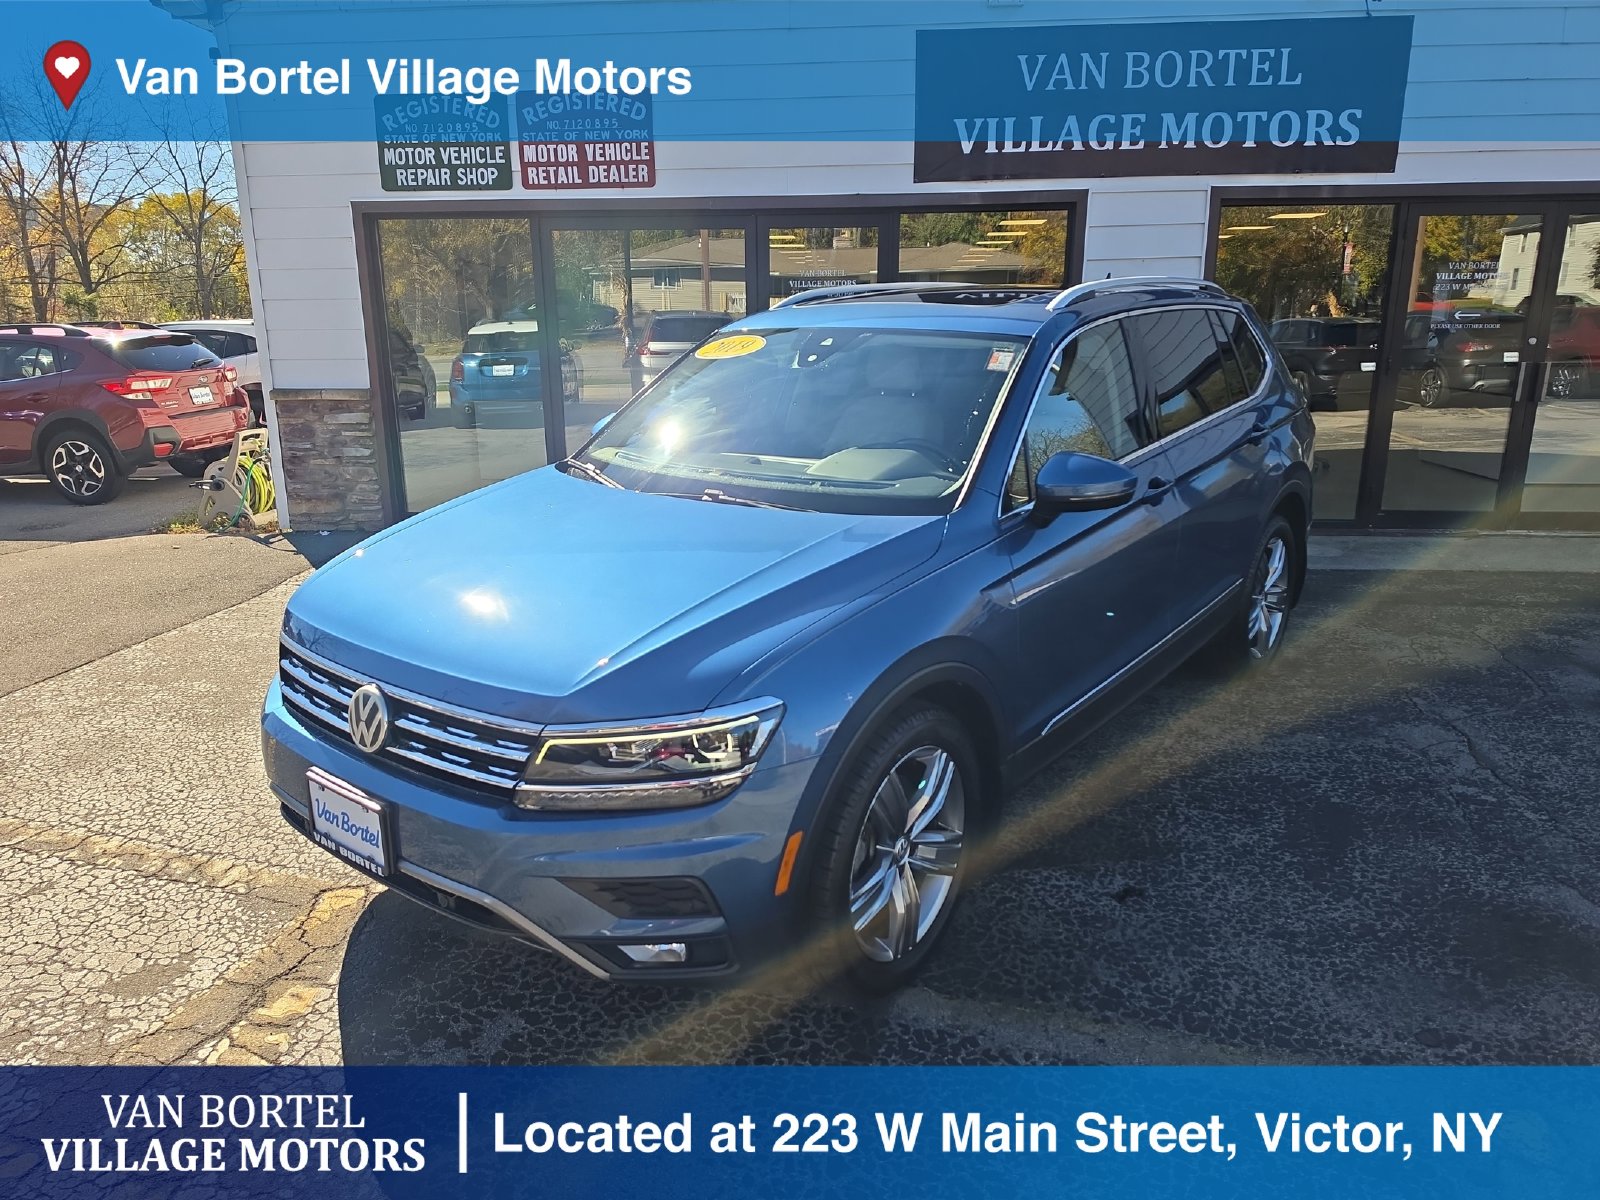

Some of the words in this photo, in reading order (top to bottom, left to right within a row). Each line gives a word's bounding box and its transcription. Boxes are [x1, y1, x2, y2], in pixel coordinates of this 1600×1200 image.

[1017, 51, 1109, 91] VAN
[1123, 48, 1303, 89] BORTEL
[382, 95, 500, 132] REGISTERED
[521, 91, 647, 126] REGISTERED
[564, 118, 619, 129] 7120895
[954, 113, 1147, 154] VILLAGE
[1158, 109, 1363, 148] MOTORS
[384, 134, 419, 144] STATE
[423, 133, 437, 144] OF
[441, 132, 467, 143] NEW
[470, 132, 502, 143] YORK
[522, 131, 558, 142] STATE
[564, 131, 579, 141] OF
[585, 130, 610, 140] NEW
[615, 129, 649, 140] YORK
[383, 147, 436, 166] MOTOR
[440, 145, 506, 165] VEHICLE
[523, 143, 578, 163] MOTOR
[584, 142, 650, 162] VEHICLE
[396, 168, 451, 186] REPAIR
[457, 167, 499, 186] SHOP
[527, 165, 583, 184] RETAIL
[588, 164, 649, 183] DEALER
[800, 269, 815, 277] VAN
[1448, 261, 1467, 270] VAN
[789, 280, 822, 288] VILLAGE
[824, 279, 857, 287] MOTORS
[1435, 272, 1473, 280] VILLAGE
[315, 798, 340, 828] Van
[340, 811, 380, 848] Bortel
[313, 831, 336, 851] VAN
[339, 845, 385, 877] BORTEL
